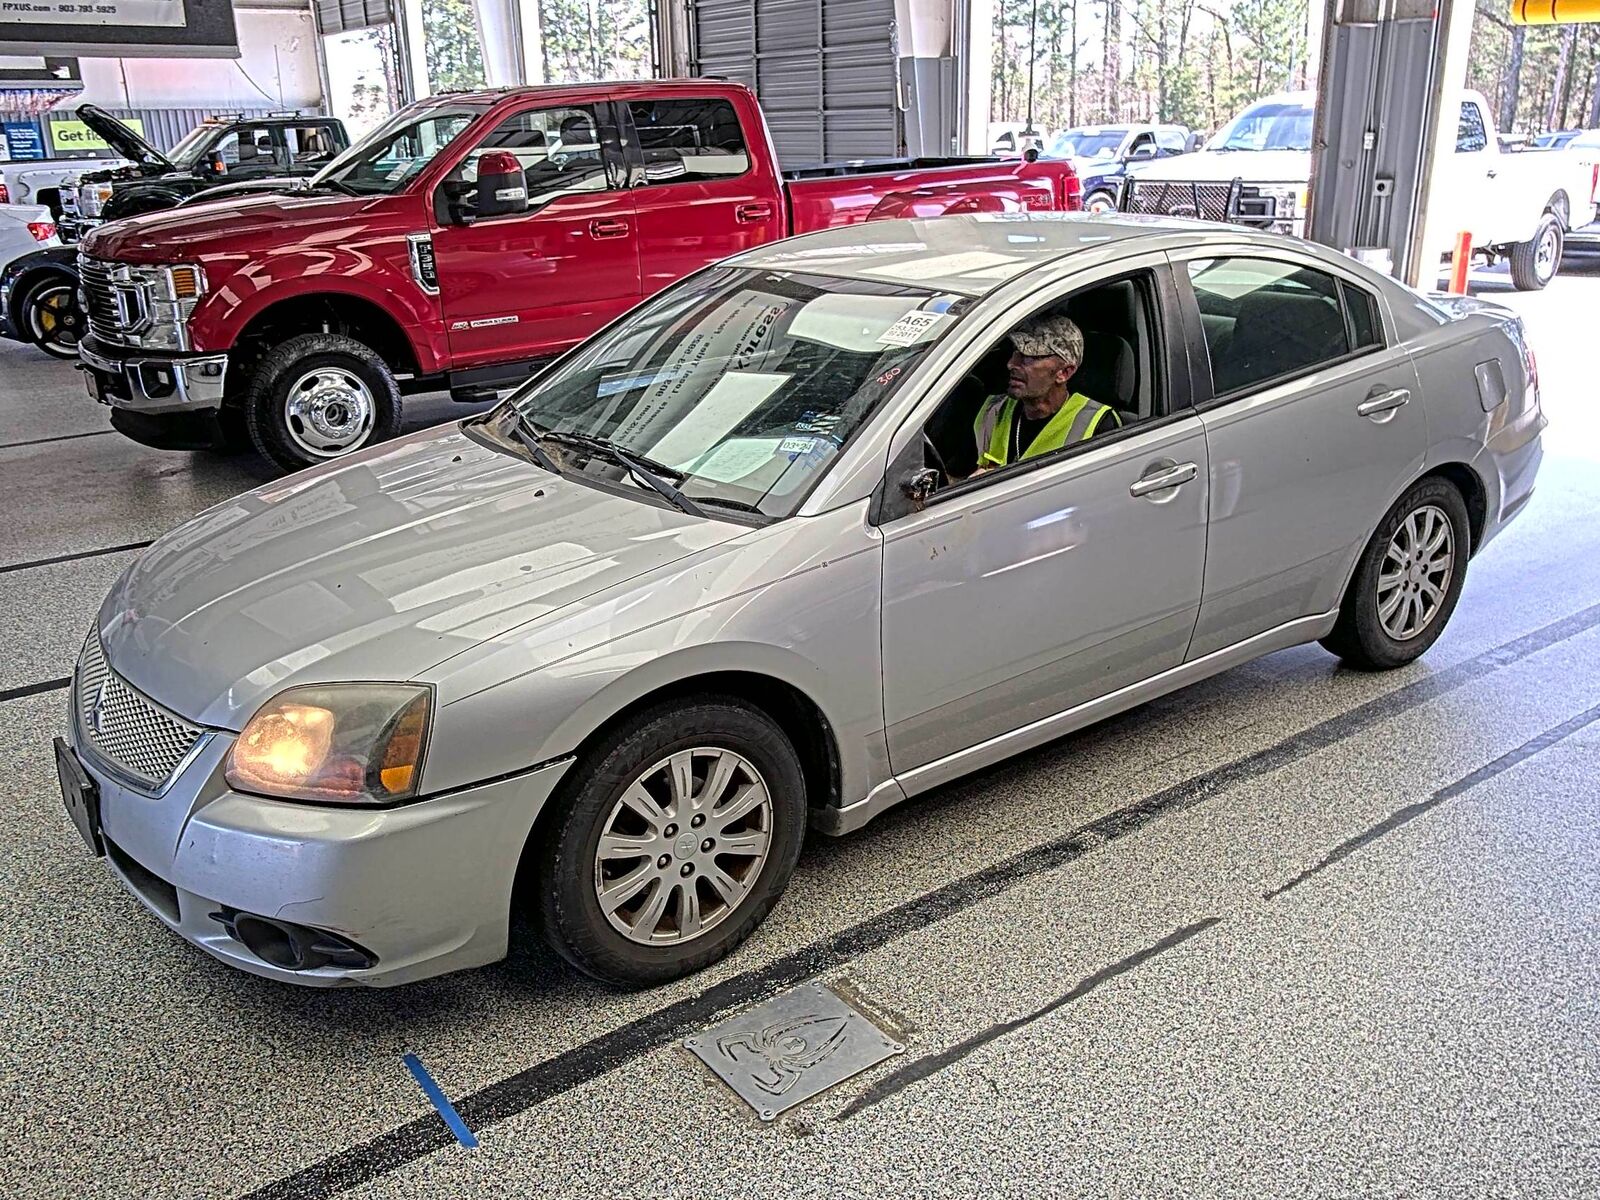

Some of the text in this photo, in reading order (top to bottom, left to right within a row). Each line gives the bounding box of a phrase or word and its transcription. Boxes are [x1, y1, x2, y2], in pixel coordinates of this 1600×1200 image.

[2, 3, 51, 12] FPXUS.com
[58, 4, 117, 14] 903-793-5925
[58, 130, 84, 142] Get
[898, 316, 933, 327] A65
[877, 368, 901, 385] 360
